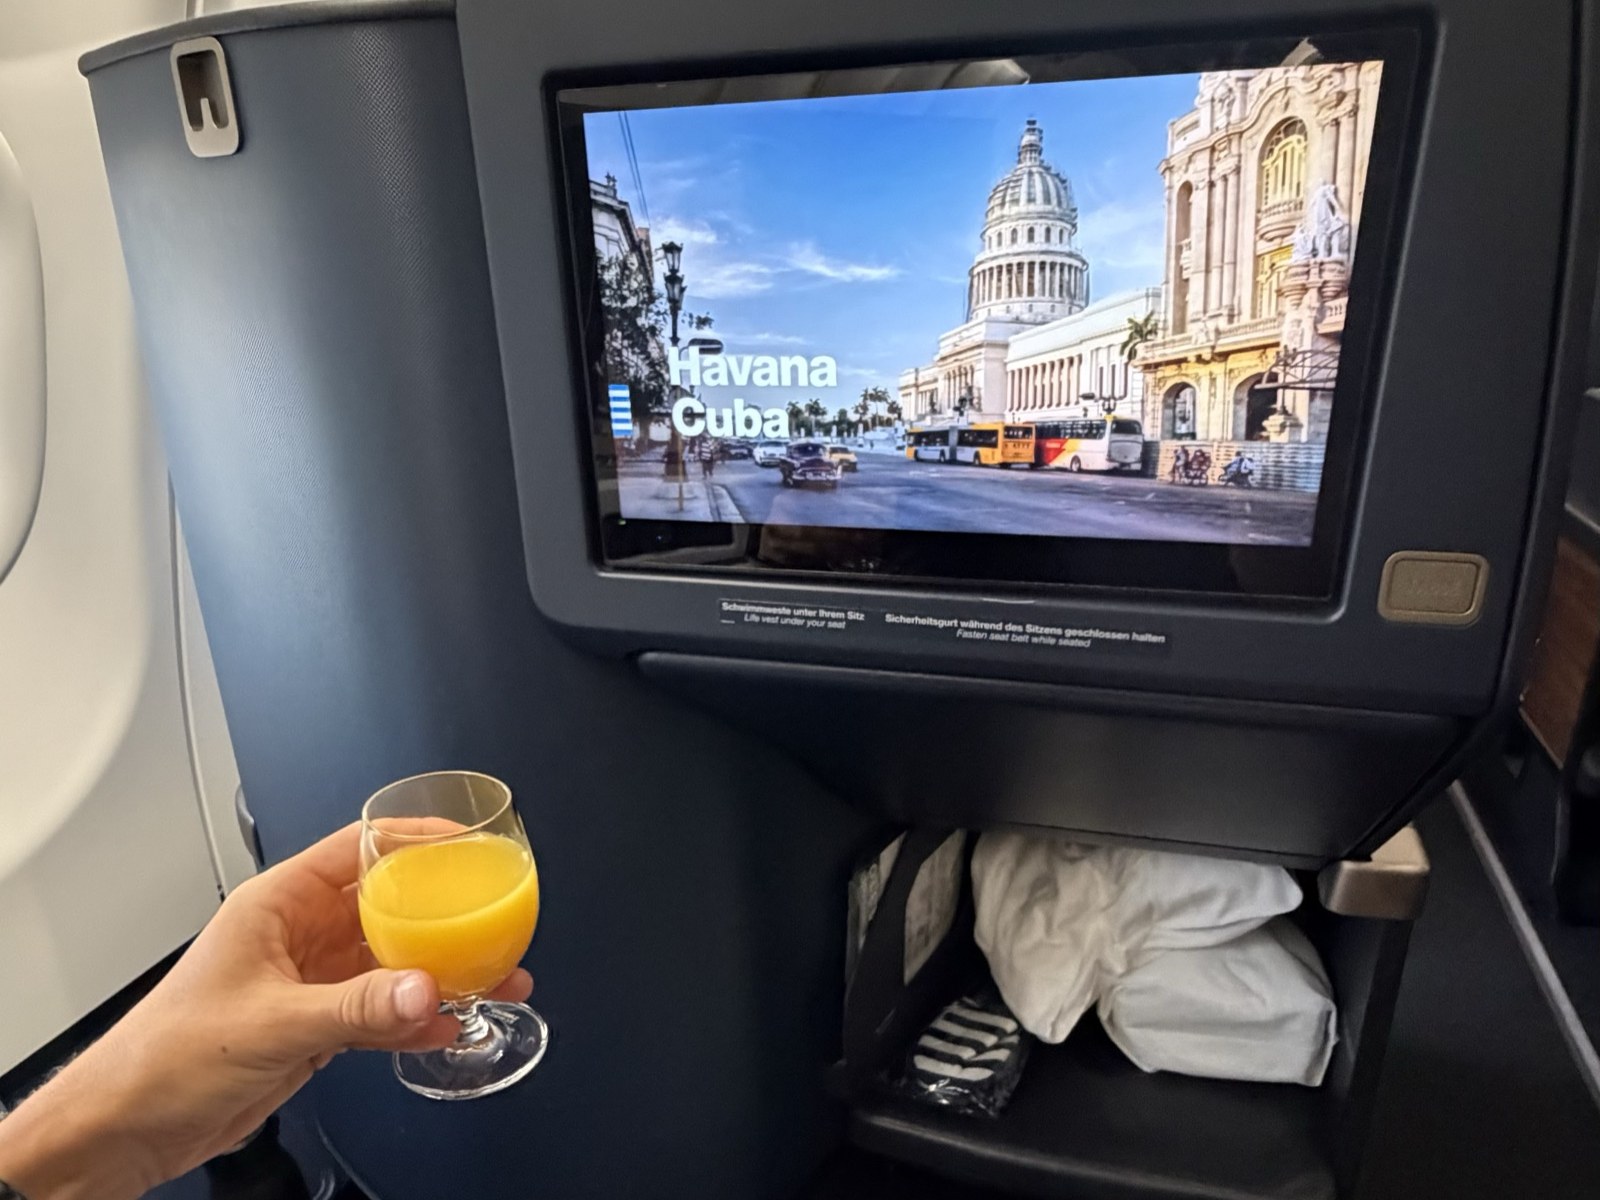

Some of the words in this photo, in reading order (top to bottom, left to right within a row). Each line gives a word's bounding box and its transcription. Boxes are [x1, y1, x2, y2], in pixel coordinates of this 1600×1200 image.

[668, 345, 837, 387] Havana
[672, 397, 790, 438] Cuba
[721, 602, 791, 615] Schwimmweste
[793, 608, 817, 618] unter
[818, 610, 845, 620] Ihrem
[847, 611, 865, 621] Sitz
[744, 613, 760, 622] Life
[761, 615, 780, 625] vest
[780, 616, 805, 626] under
[806, 617, 825, 629] your
[827, 620, 846, 629] seat
[885, 613, 958, 628] Sicherheitsgurt
[960, 618, 1003, 631] während
[1005, 621, 1024, 632] des
[1025, 623, 1063, 635] Sitzens
[1065, 628, 1130, 641] geschlossen
[1132, 633, 1166, 643] halten
[956, 629, 988, 640] Fasten
[989, 631, 1010, 641] seat
[1011, 632, 1030, 643] belt
[1031, 634, 1056, 645] while
[1058, 637, 1092, 648] seated
